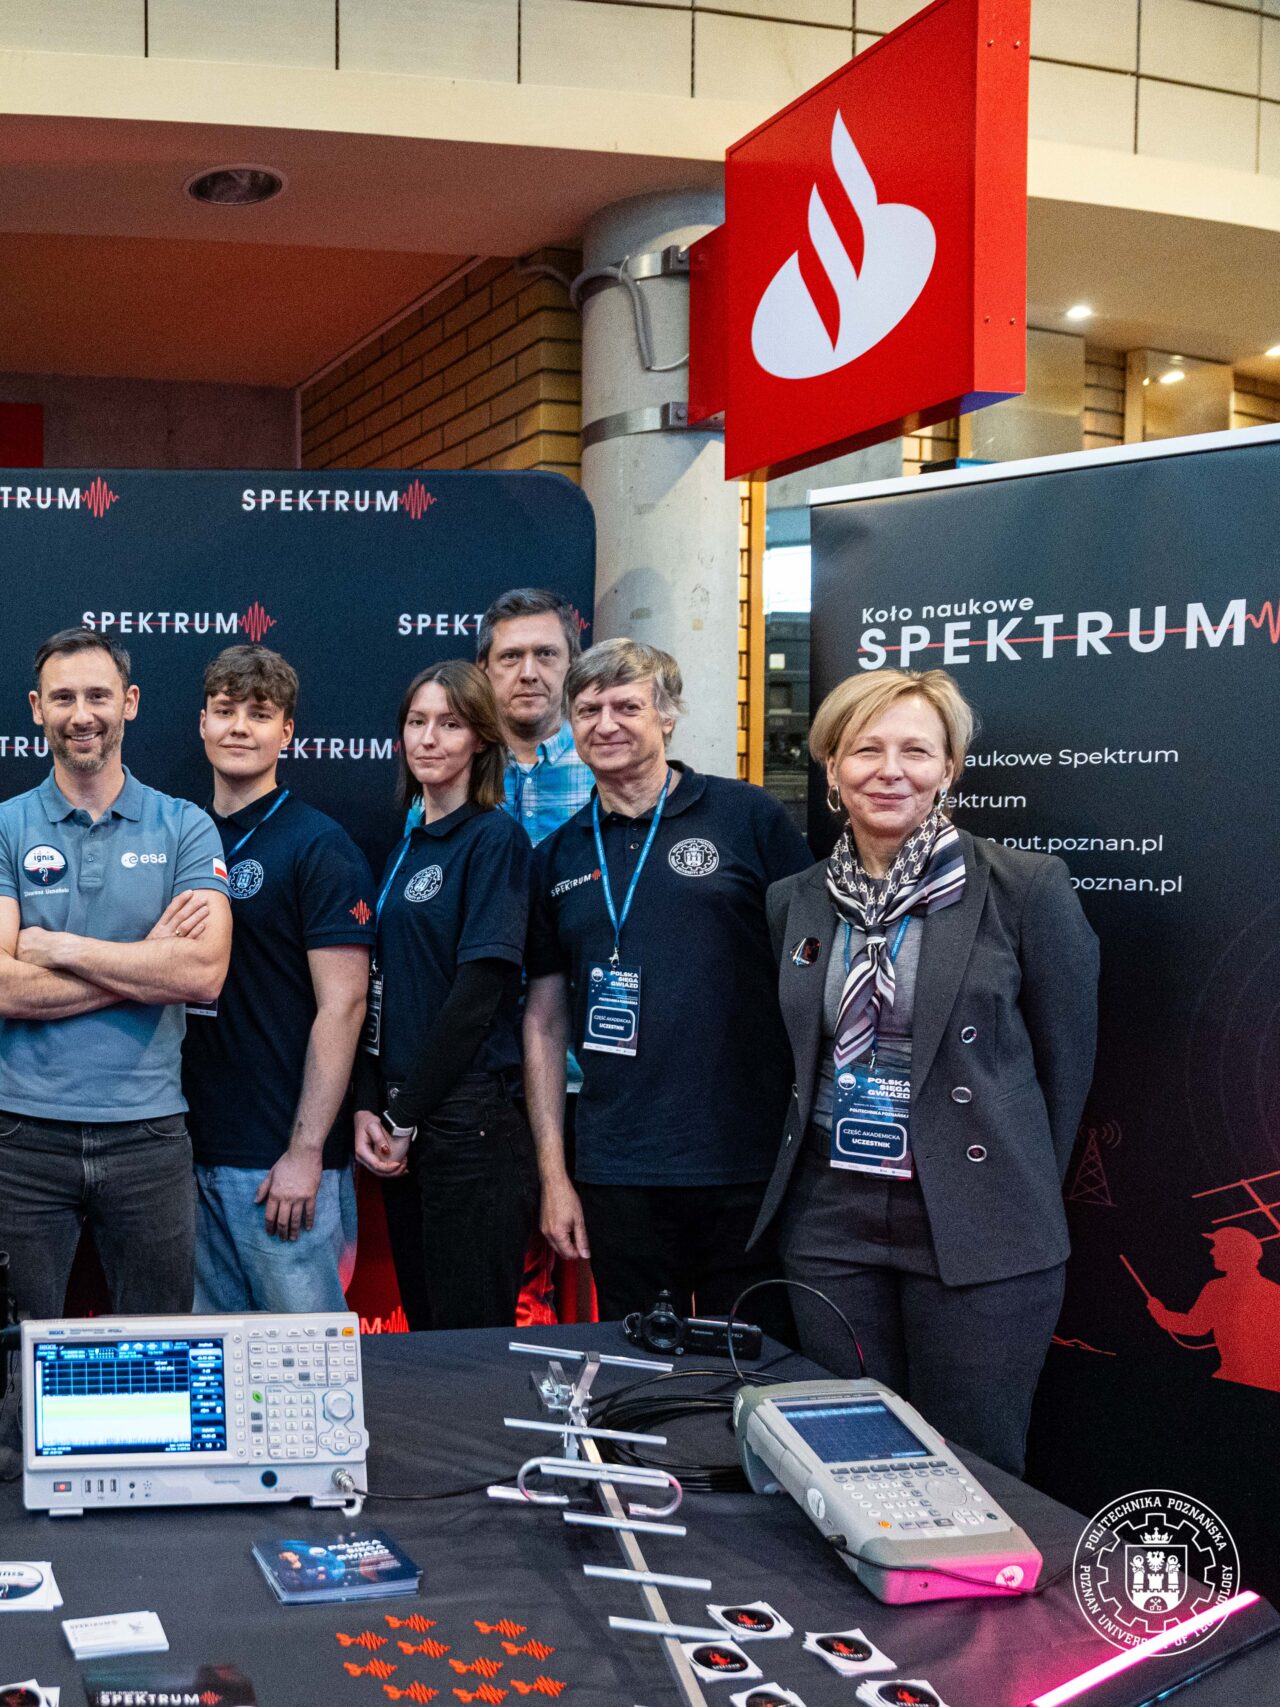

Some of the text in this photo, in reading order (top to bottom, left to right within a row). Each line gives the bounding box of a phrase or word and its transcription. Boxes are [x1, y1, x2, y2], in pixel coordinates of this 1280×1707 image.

[241, 489, 399, 512] SPEKTRUM
[862, 597, 1034, 625] Koło naukowe
[82, 611, 238, 634] SPEKTRUM
[858, 598, 1247, 671] SPEKTRUM
[1058, 747, 1180, 769] Spektrum
[34, 851, 55, 863] ignis
[139, 853, 167, 864] esa
[551, 872, 592, 898] SPEKTRUM
[867, 1077, 911, 1087] POLSKA
[867, 1090, 911, 1100] GWIAZD
[862, 1130, 901, 1141] AKADEMICKA
[851, 1138, 891, 1149] UCZESTNIK
[99, 1692, 200, 1707] SPEKTRUM
